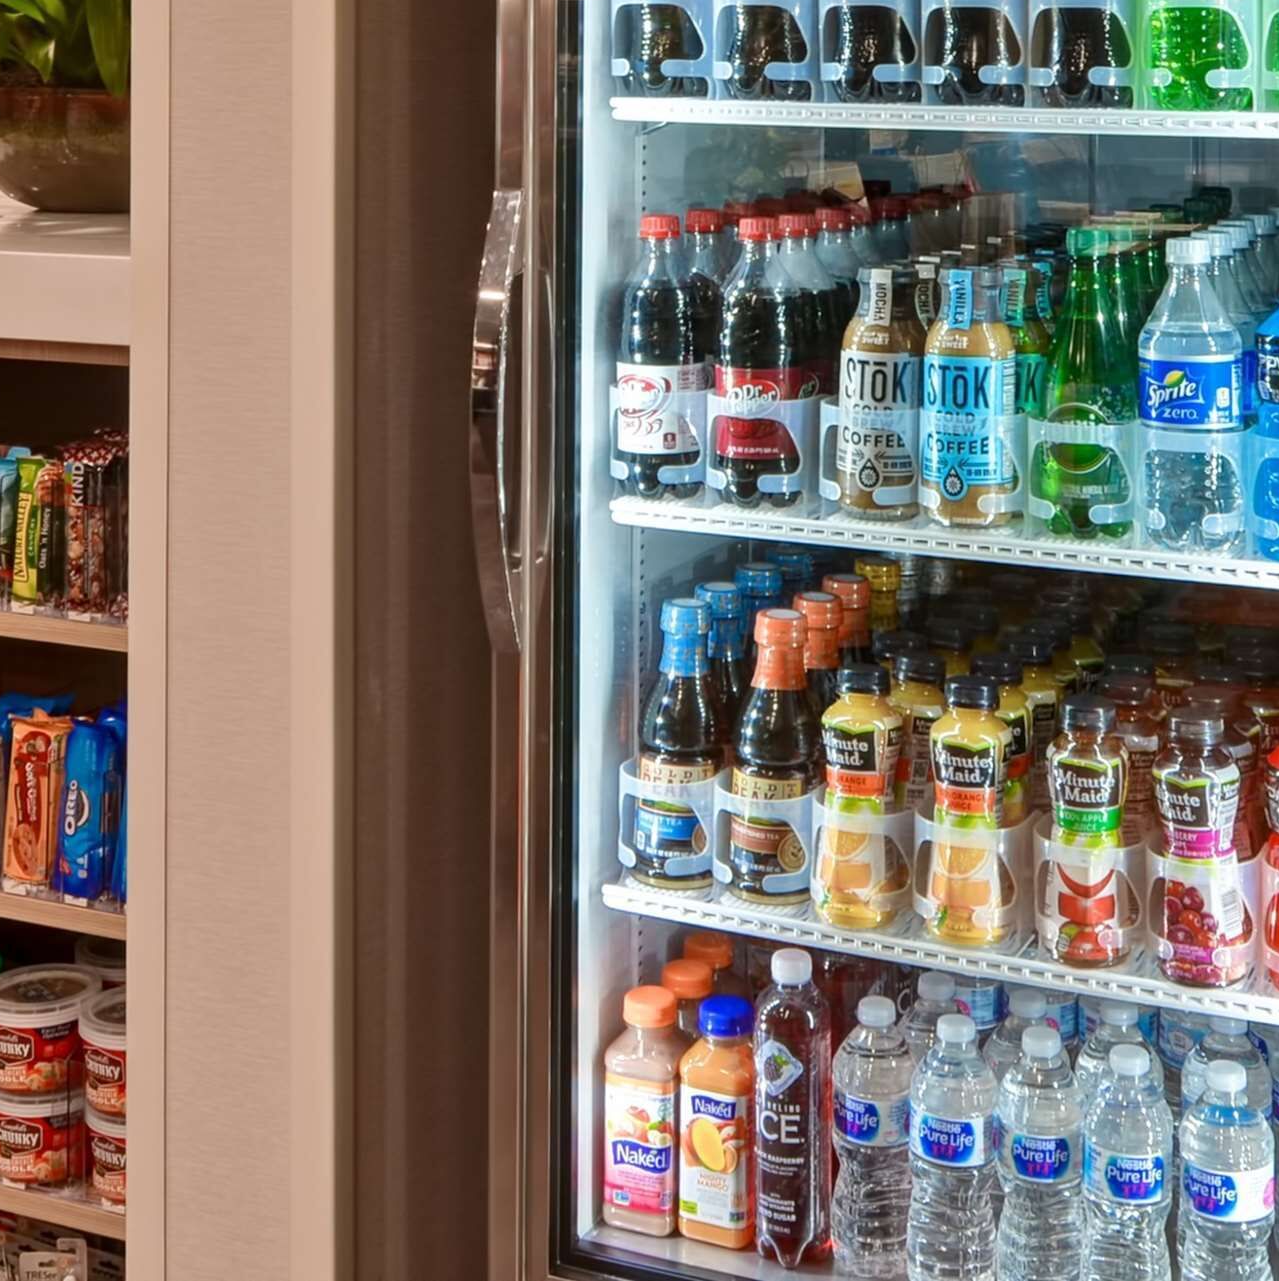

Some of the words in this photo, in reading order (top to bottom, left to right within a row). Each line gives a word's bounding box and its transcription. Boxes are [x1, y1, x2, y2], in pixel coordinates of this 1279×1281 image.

[1147, 379, 1197, 405] Sprite
[1161, 406, 1198, 420] zero
[70, 463, 86, 508] KIND
[1058, 770, 1116, 789] Minute
[1064, 786, 1106, 804] Maid
[694, 1099, 733, 1120] Naked
[616, 1145, 667, 1171] Naked
